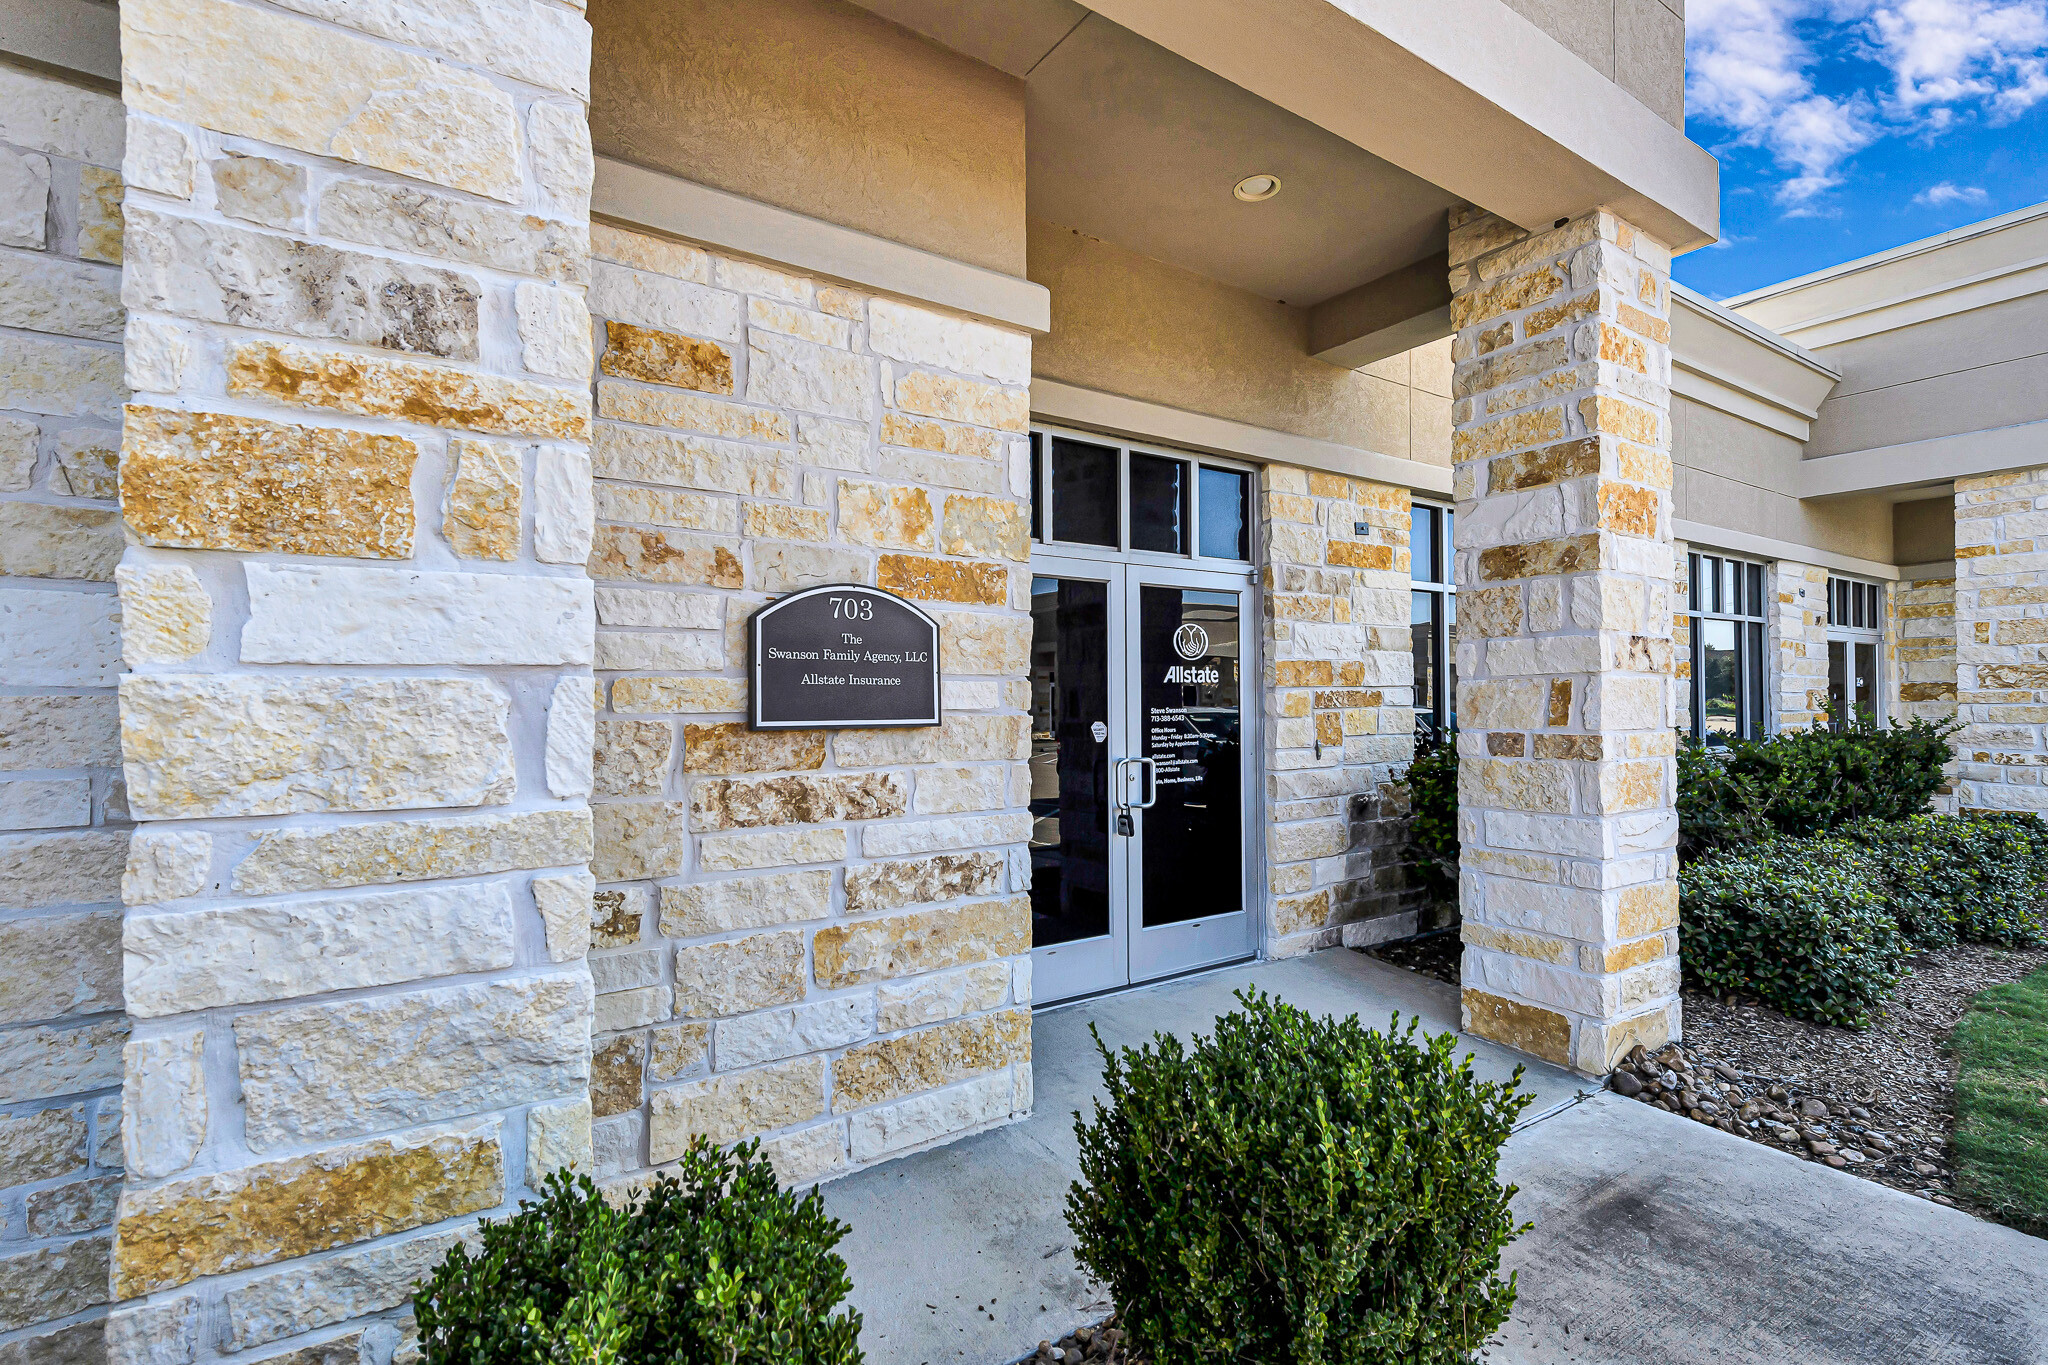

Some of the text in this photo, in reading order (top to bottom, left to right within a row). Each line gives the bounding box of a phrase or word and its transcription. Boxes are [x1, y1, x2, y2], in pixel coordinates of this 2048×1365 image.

[829, 597, 873, 620] 703
[841, 633, 863, 645] The
[768, 648, 928, 664] Swanson Family Agency, LLC
[801, 674, 901, 685] Allstate Insurance
[1163, 666, 1219, 683] Allstate
